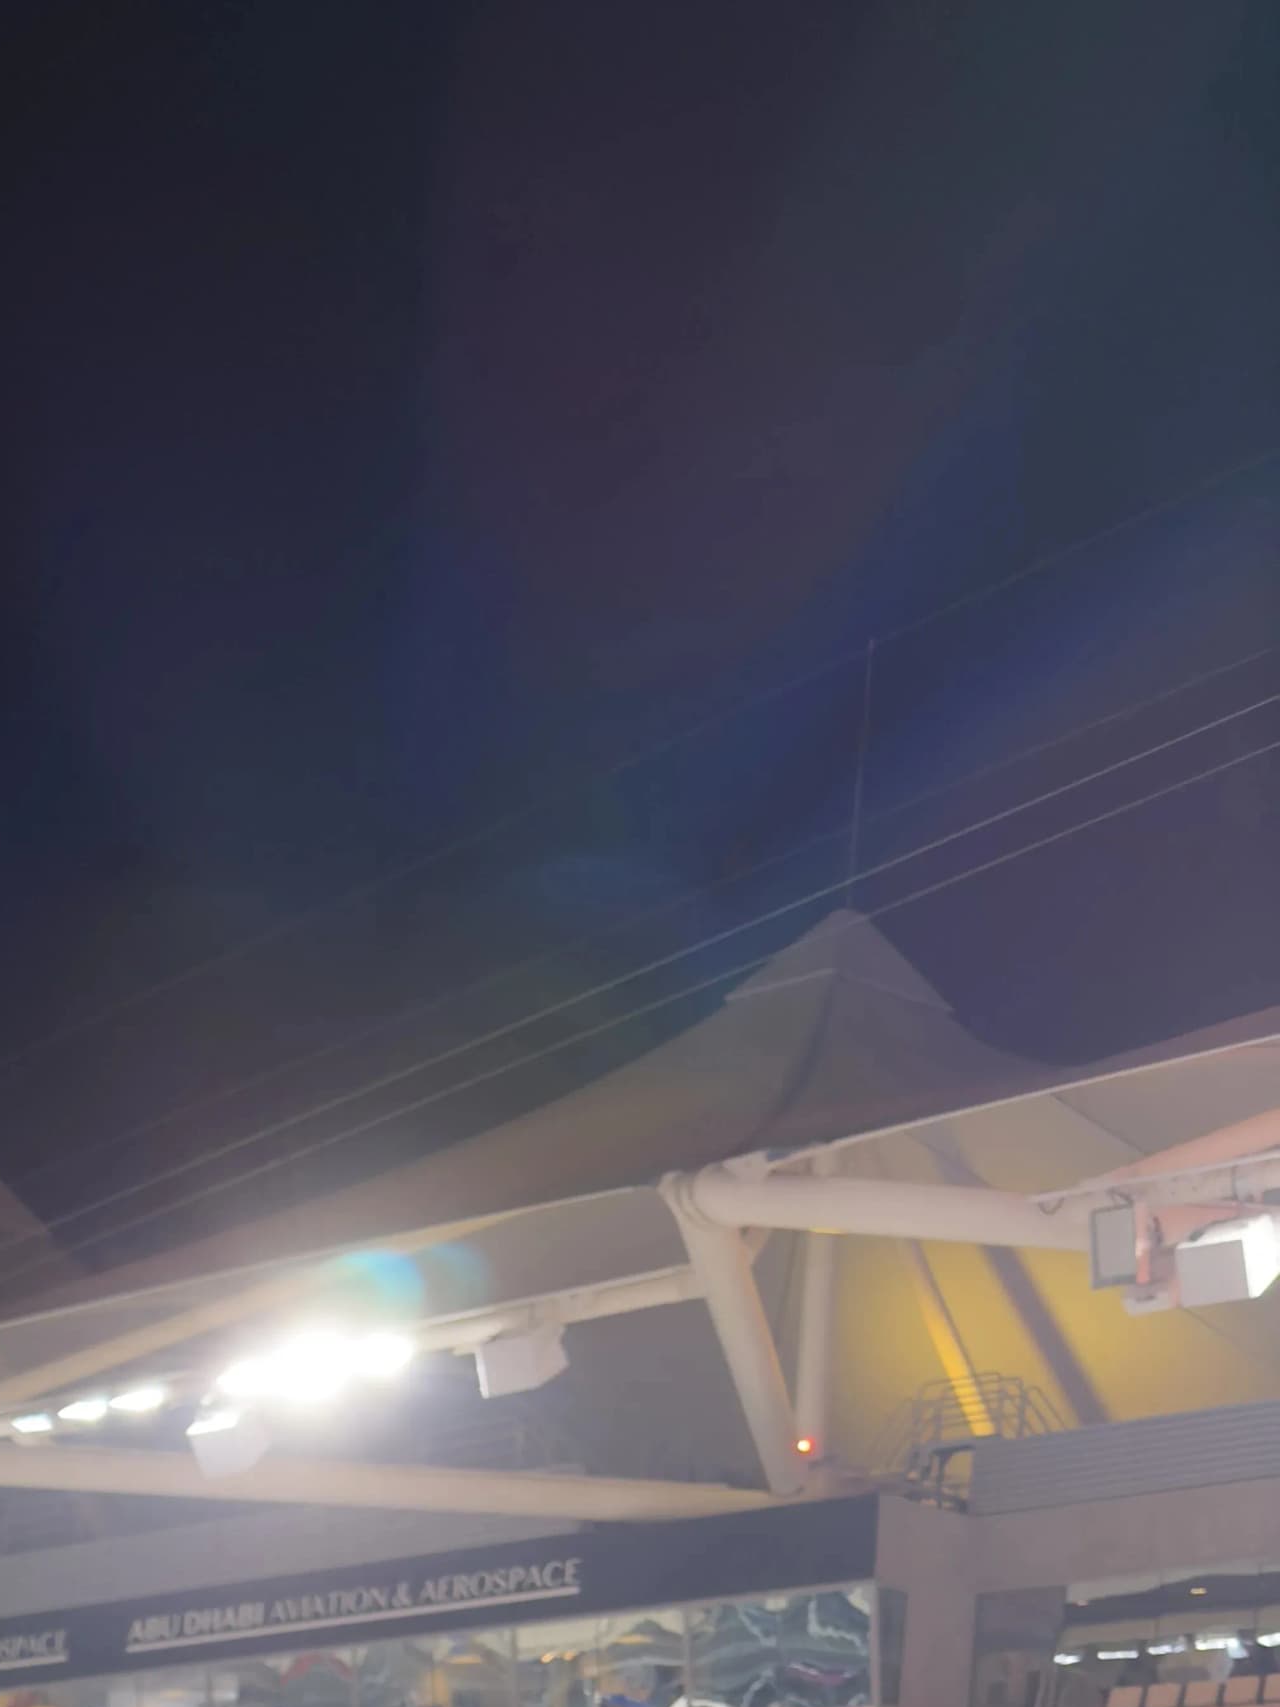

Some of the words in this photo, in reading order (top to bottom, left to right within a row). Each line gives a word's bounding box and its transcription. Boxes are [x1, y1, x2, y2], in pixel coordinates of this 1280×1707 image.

[127, 1616, 182, 1643] ABU
[184, 1602, 265, 1638] DHABI
[269, 1584, 389, 1624] AVIATION
[391, 1580, 412, 1607] &
[420, 1557, 582, 1602] AEROSPACE
